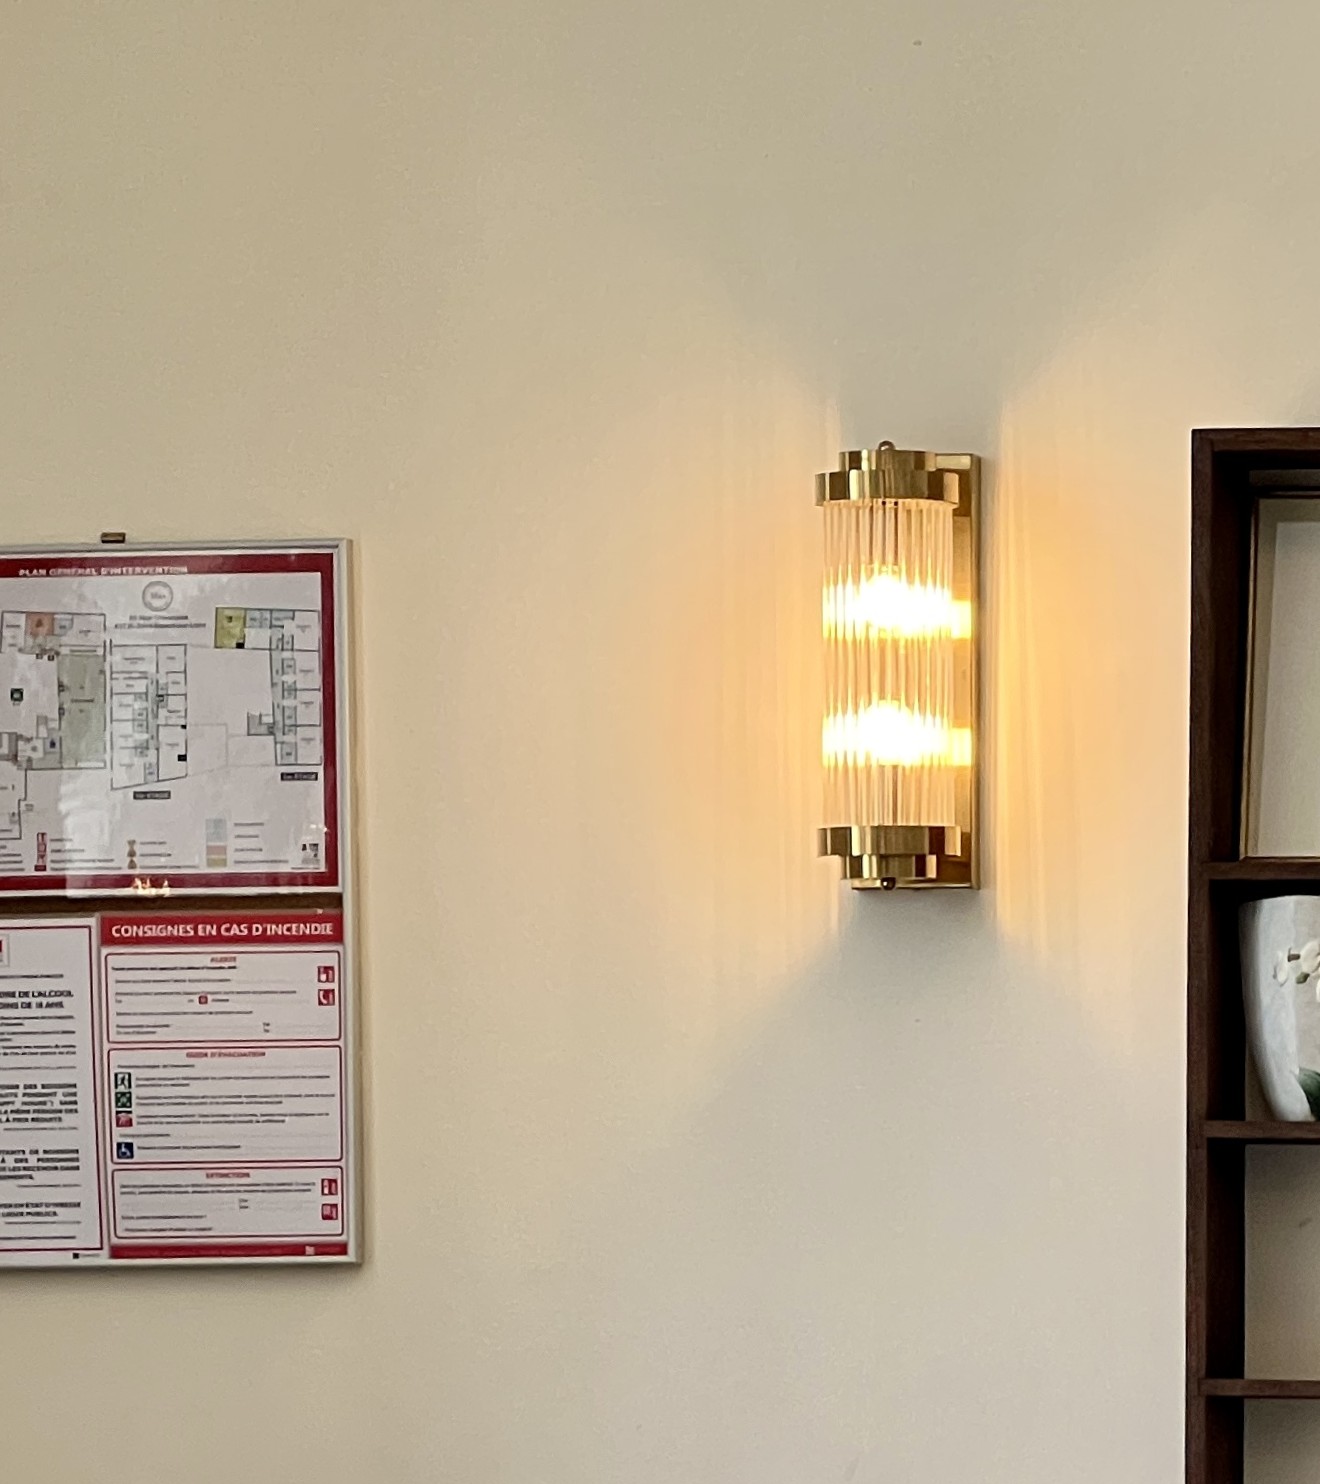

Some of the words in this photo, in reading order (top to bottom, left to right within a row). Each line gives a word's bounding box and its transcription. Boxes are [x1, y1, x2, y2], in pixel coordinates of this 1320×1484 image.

[111, 924, 194, 938] CONSIGNES
[197, 924, 216, 937] EN
[220, 923, 248, 936] CAS
[252, 922, 334, 936] D'INCENDIE
